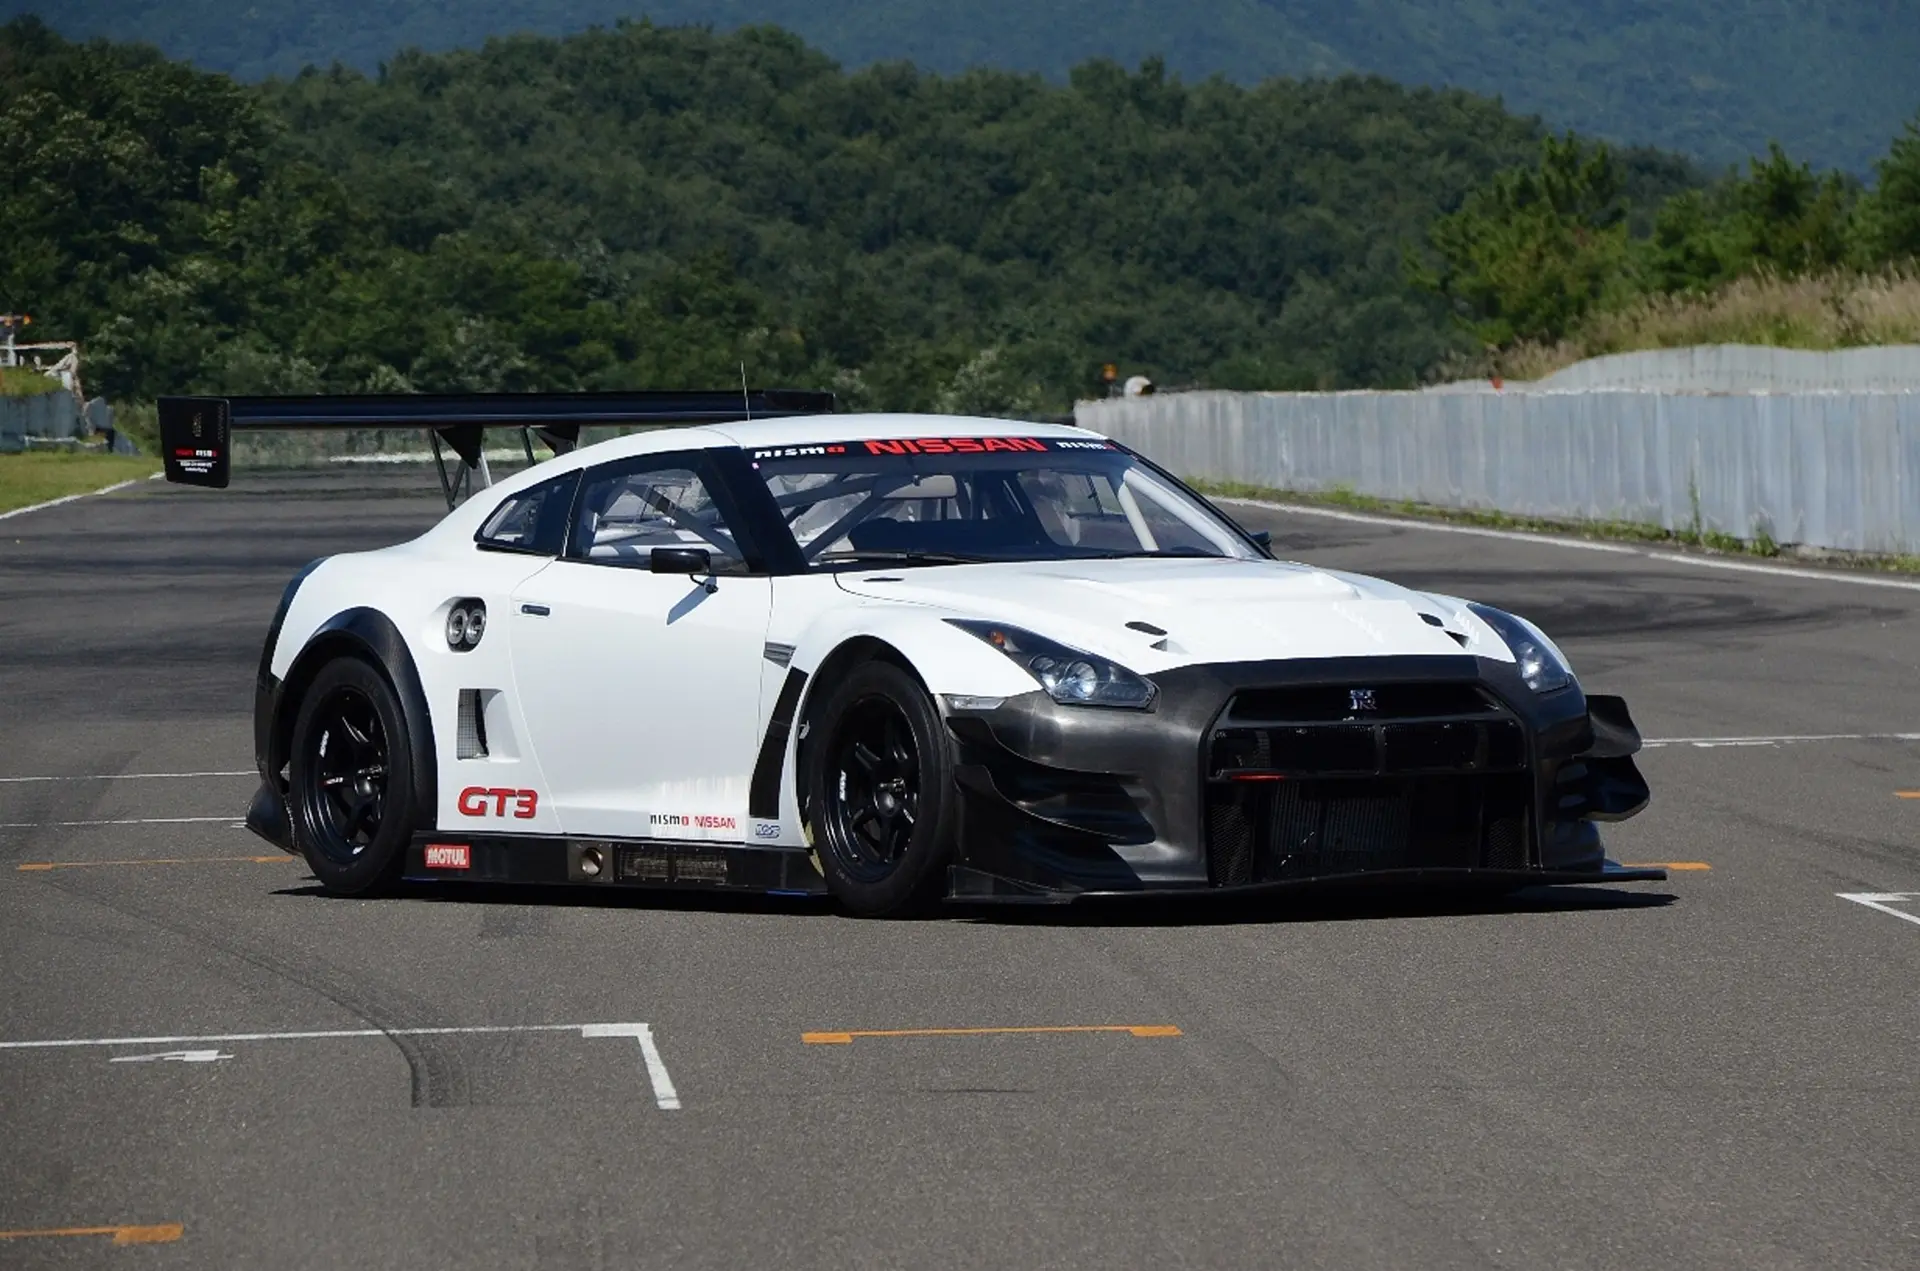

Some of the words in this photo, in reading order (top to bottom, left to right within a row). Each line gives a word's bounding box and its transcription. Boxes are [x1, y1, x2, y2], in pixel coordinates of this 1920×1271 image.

[754, 446, 845, 459] nismo
[864, 437, 1048, 454] NISSAN
[457, 786, 538, 819] GT3
[650, 814, 689, 826] nismo
[694, 815, 736, 829] NISSAN
[426, 848, 467, 865] MOTUL
